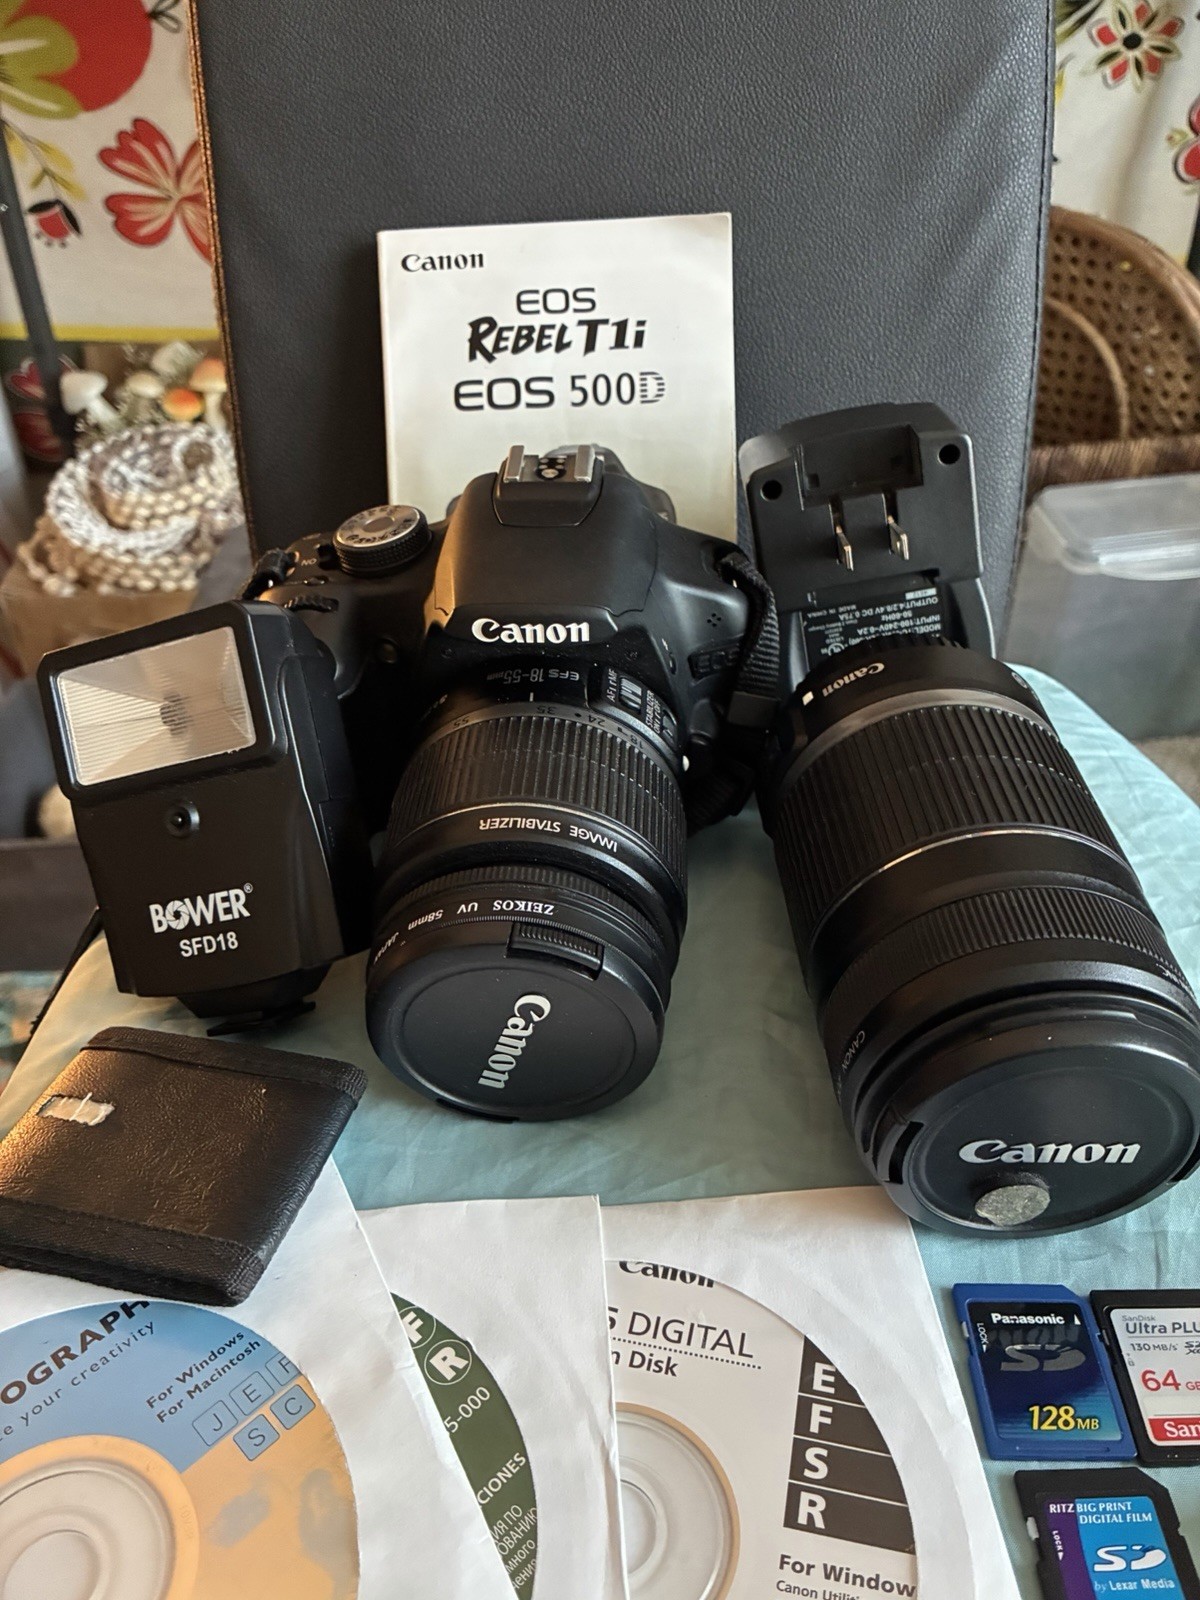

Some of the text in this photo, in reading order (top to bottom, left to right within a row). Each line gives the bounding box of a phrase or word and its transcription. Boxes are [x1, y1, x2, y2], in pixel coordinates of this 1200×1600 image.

[401, 252, 485, 272] Canon
[516, 287, 596, 315] EOS
[468, 316, 647, 364] REBEL T1i
[454, 371, 666, 412] EOS 500D
[471, 617, 590, 644] Canon
[822, 662, 885, 697] Canon
[536, 705, 556, 715] 35
[479, 817, 618, 853] IMAGE STABILIZER
[408, 899, 555, 931] ZEIKOS UV 58mm
[179, 931, 239, 958] SFD18
[477, 994, 552, 1089] Canon
[959, 1139, 1142, 1165] Canon
[402, 1310, 424, 1344] F
[628, 1311, 754, 1358] DIGITAL
[977, 1323, 989, 1344] LOCK
[990, 1313, 1065, 1325] Panasonic
[1125, 1322, 1167, 1334] Ultra
[1130, 1343, 1151, 1351] 130
[20, 1387, 63, 1427] your
[71, 1321, 155, 1387] creativity
[146, 1332, 245, 1409] For Windows
[429, 1346, 469, 1381] R
[628, 1350, 678, 1377] Disk
[812, 1363, 837, 1394] E
[156, 1340, 261, 1423] For Macintosh
[1141, 1369, 1181, 1392] 64
[212, 1413, 224, 1432] J
[242, 1383, 262, 1403] E
[247, 1397, 303, 1447] S C
[809, 1403, 833, 1434] F
[803, 1446, 829, 1480] S
[477, 1452, 527, 1507] CIONES
[797, 1491, 826, 1529] R
[1049, 1501, 1132, 1514] RITZ BIG PRINT
[1079, 1512, 1152, 1524] DIGITAL FILM
[496, 1507, 538, 1555] ОВАНИЮ
[1052, 1530, 1064, 1551] LOCK
[776, 1580, 818, 1600] Canon
[779, 1554, 917, 1598] For Window
[1094, 1578, 1175, 1593] by Lexar Media
